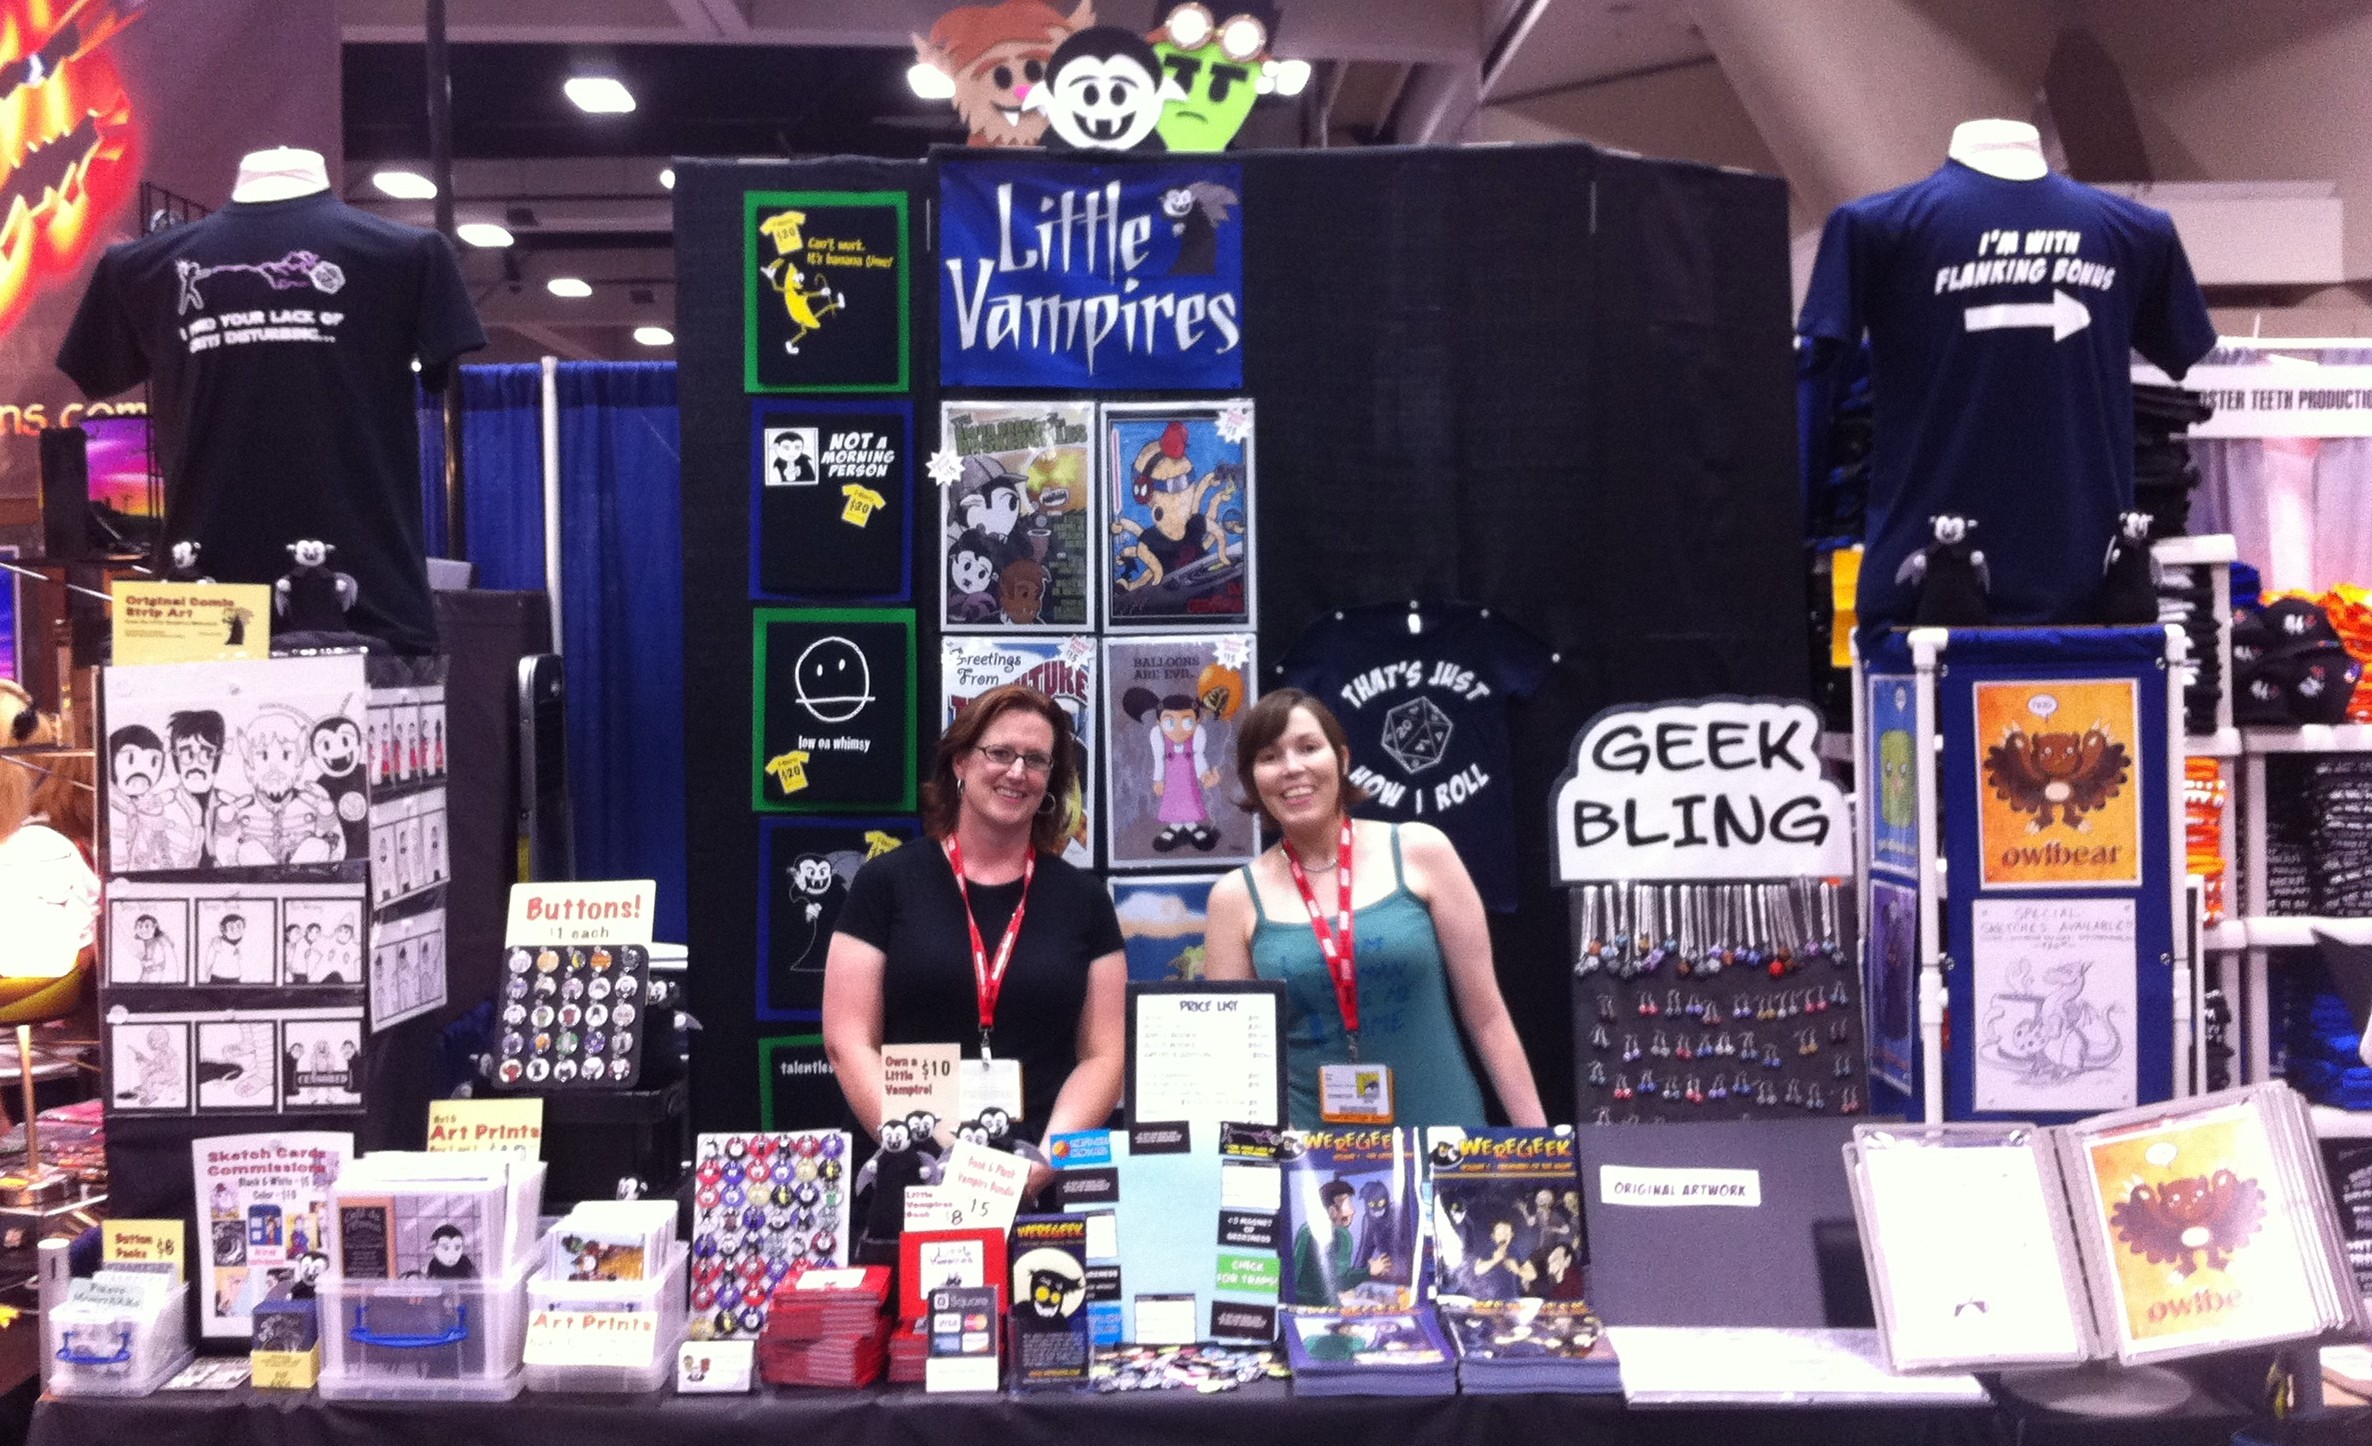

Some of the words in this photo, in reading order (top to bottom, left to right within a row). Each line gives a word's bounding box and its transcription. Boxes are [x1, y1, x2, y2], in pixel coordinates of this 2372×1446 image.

[998, 180, 1152, 285] Little
[1979, 229, 2019, 257] I'M
[2025, 229, 2081, 255] WITH
[1935, 257, 2048, 295] FLANKING
[2052, 257, 2116, 291] BONUS
[219, 310, 266, 328] YOUR
[270, 309, 316, 325] LACK
[946, 258, 1240, 376] Vampires
[2252, 390, 2294, 411] TEETH
[829, 432, 874, 451] NOT
[876, 436, 888, 450] A
[821, 449, 895, 465] MORNING
[828, 464, 888, 478] PERSON
[126, 595, 187, 607] Original
[189, 597, 235, 607] Comic
[126, 607, 163, 618] Strip
[167, 608, 193, 618] Art
[1133, 655, 1200, 669] BALLOONS
[957, 667, 1000, 687] From
[1341, 660, 1423, 709] THAT'S
[1428, 660, 1491, 701] JUST
[798, 735, 817, 750] low
[818, 738, 832, 750] on
[833, 736, 871, 753] whimsy
[1592, 720, 1804, 775] GEEK
[1349, 765, 1407, 808] HOW
[1415, 788, 1423, 815] I
[1434, 763, 1490, 812] ROLL
[1574, 793, 1830, 849] BLING
[2002, 842, 2122, 867] owlbear
[526, 894, 642, 921] Buttons!
[571, 926, 609, 939] each
[1179, 1000, 1212, 1012] PRICE
[1216, 1000, 1239, 1012] LIST
[885, 1056, 908, 1067] Own
[921, 1059, 951, 1081] $10
[429, 1124, 470, 1141] Art
[475, 1123, 542, 1140] Prints
[1302, 1131, 1392, 1153] WEREGEE
[207, 1148, 272, 1164] Sketch
[1459, 1136, 1573, 1160] WEREGEEK
[206, 1163, 327, 1178] Commissions
[1614, 1181, 1677, 1197] ORIGINAL
[1682, 1184, 1747, 1197] ARTWORK
[532, 1312, 575, 1330] Art
[582, 1313, 653, 1332] Prints
